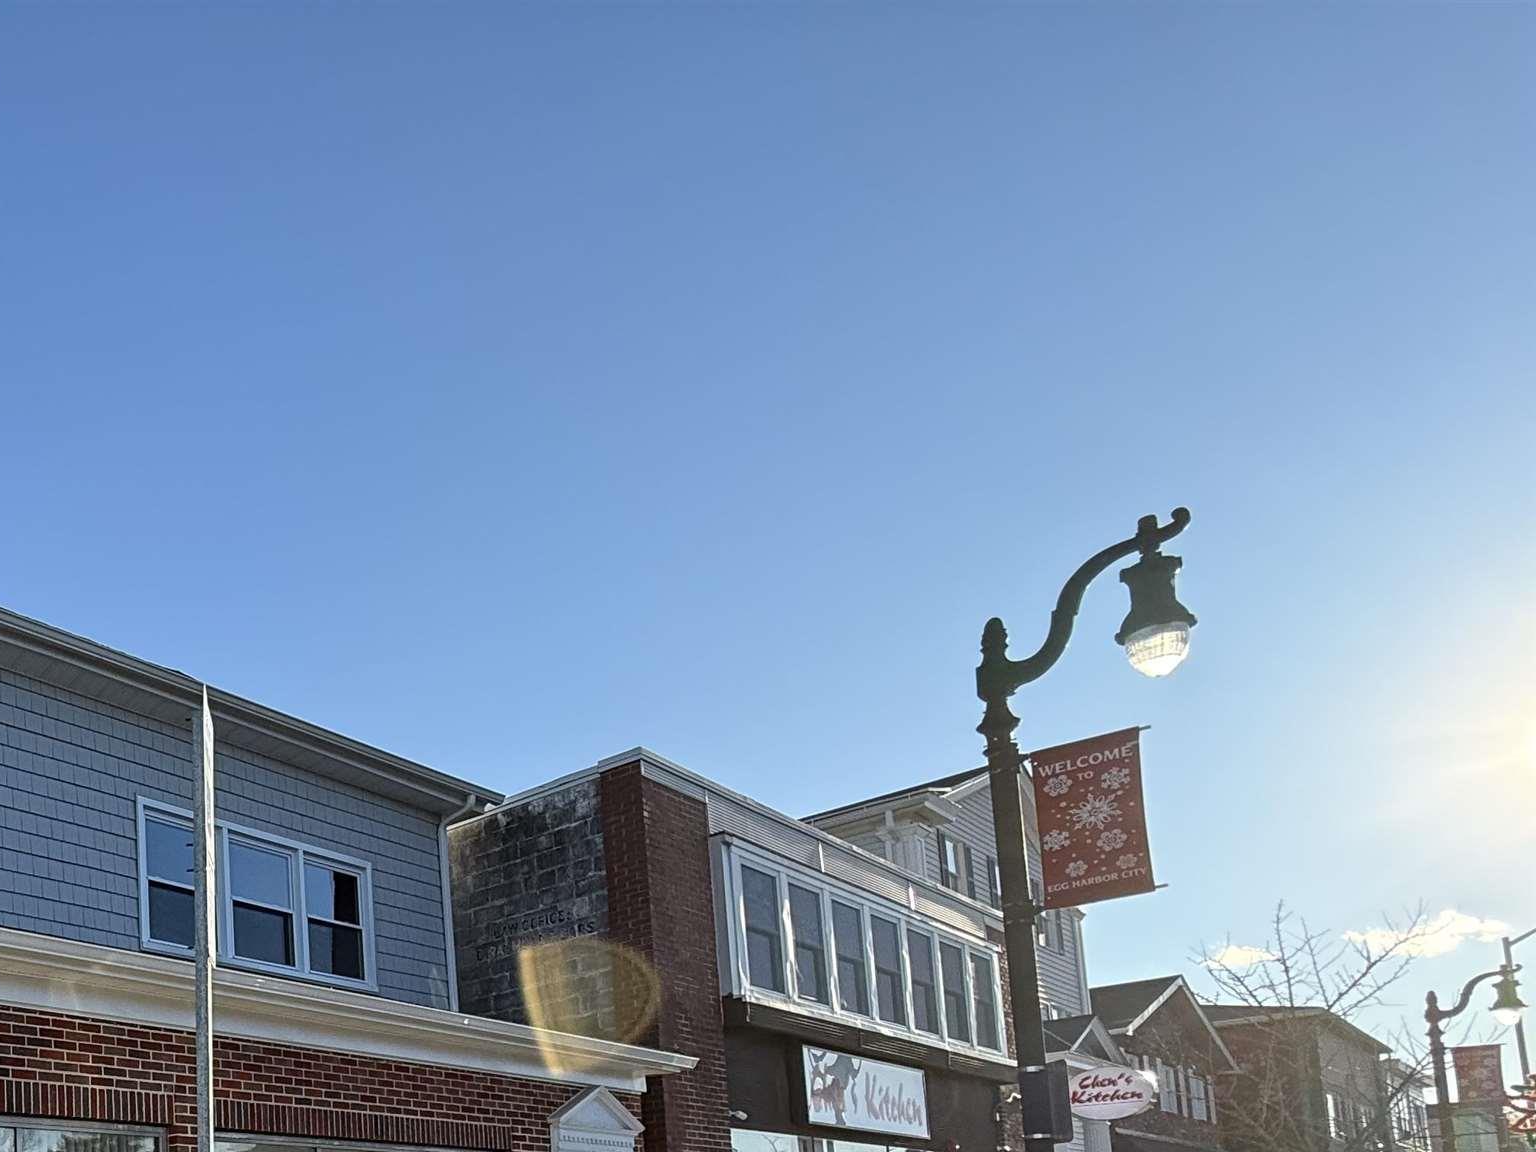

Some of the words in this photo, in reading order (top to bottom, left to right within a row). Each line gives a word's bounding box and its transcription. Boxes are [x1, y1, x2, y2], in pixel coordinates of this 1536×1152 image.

[1038, 744, 1135, 778] WELCOME
[1076, 770, 1095, 782] TO
[1047, 880, 1070, 893] EGG
[1072, 872, 1119, 888] HARBOR
[1121, 867, 1148, 879] CITY
[864, 1071, 924, 1127] Kitchen
[1070, 1089, 1144, 1105] Kitchen
